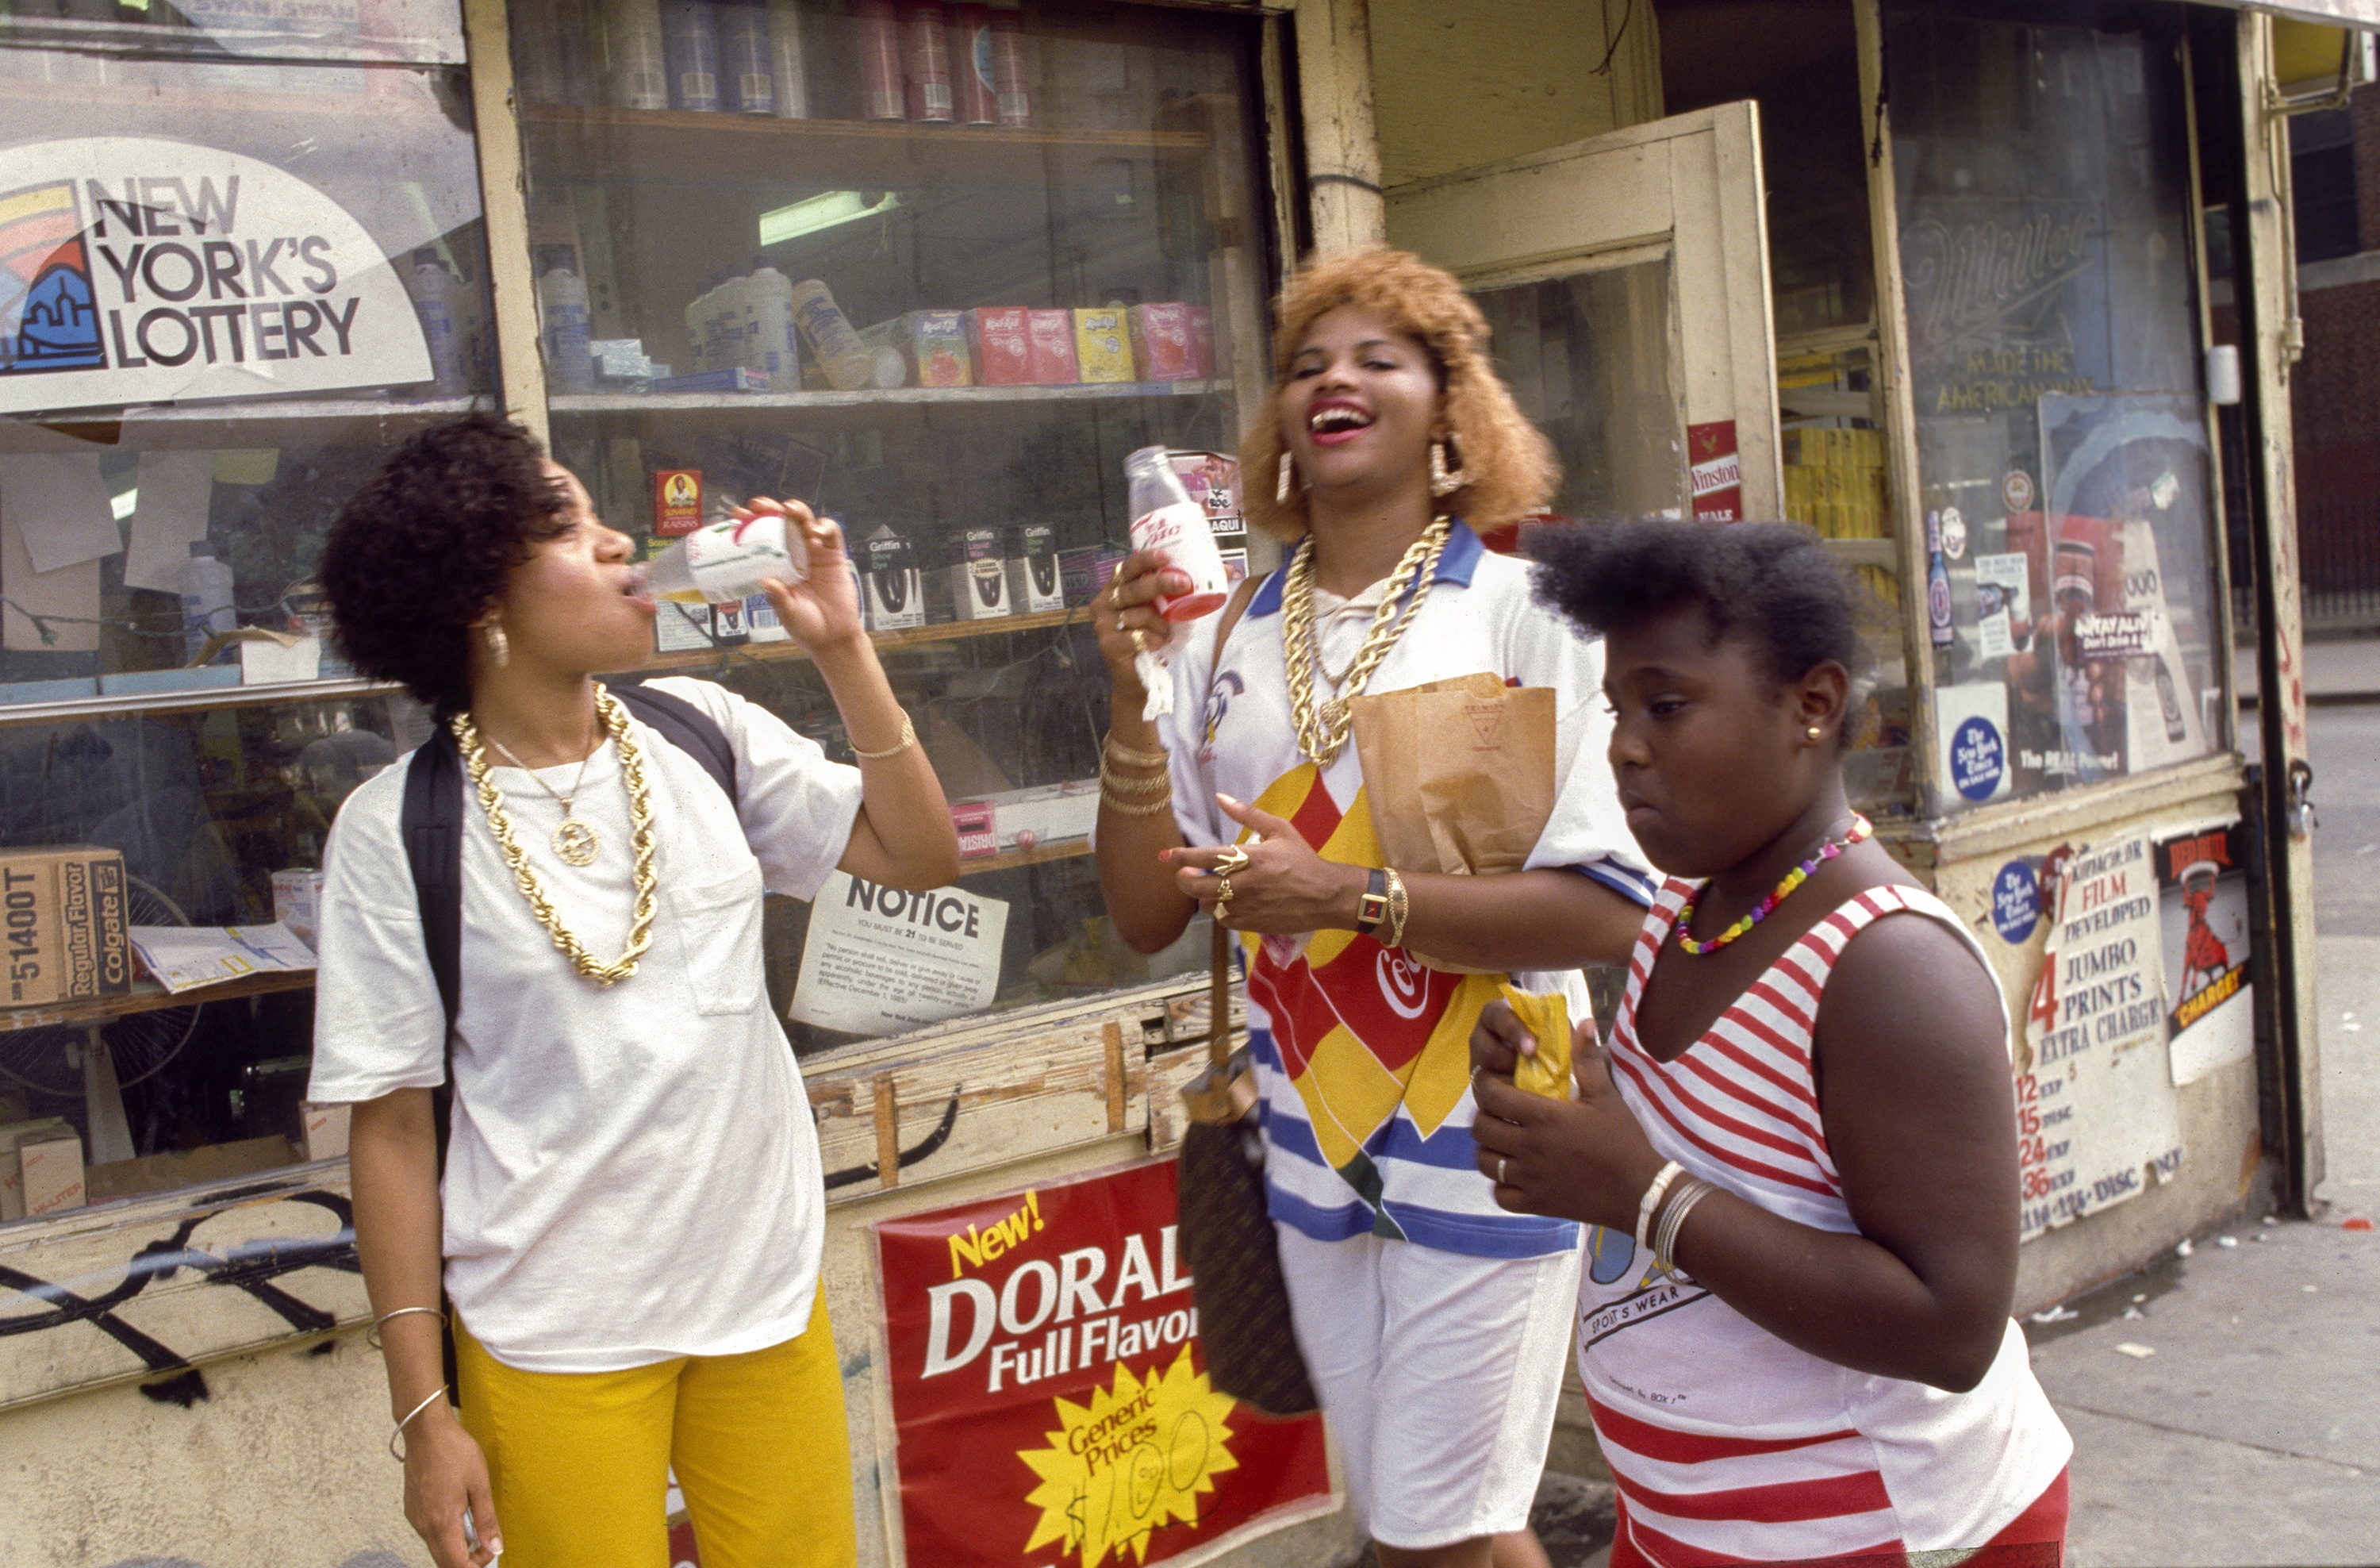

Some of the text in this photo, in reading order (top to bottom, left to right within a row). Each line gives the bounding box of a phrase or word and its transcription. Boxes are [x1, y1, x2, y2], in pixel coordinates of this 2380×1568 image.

[86, 175, 240, 237] NEW
[97, 236, 337, 304] YORK'S
[109, 297, 361, 369] LOTTERY
[2033, 347, 2070, 374] THE
[869, 540, 901, 552] Griffin
[966, 530, 994, 541] Griffin
[1025, 526, 1051, 537] Griffin
[2020, 748, 2044, 769] The
[958, 833, 997, 851] DRISTA
[846, 876, 979, 940] NOTICE
[2082, 871, 2128, 912] FILM
[4, 867, 40, 981] 51400T
[65, 861, 95, 998] Regular Flavor
[102, 894, 126, 985] Colgate
[857, 918, 873, 928] YOU
[873, 922, 892, 933] MUST
[904, 928, 916, 939] 21
[918, 933, 927, 942] TO
[938, 939, 964, 951] SERVED
[2063, 896, 2152, 943] DEVELOPED
[2064, 937, 2137, 985] JUMBO
[2030, 950, 2059, 1033] 4
[2064, 972, 2143, 1024] PRINTS
[2039, 997, 2161, 1067] EXTRA CHARGE
[2015, 1074, 2038, 1105] 12
[2017, 1105, 2041, 1135] 15
[2019, 1136, 2048, 1167] 24
[2022, 1166, 2052, 1201] 36
[2093, 1167, 2140, 1204] DISC
[947, 1188, 1045, 1279] New!
[919, 1224, 1195, 1379] DORAL
[1634, 1286, 1679, 1313] WEAR
[988, 1327, 1073, 1393] Full
[1649, 1389, 1669, 1405] BOX
[1066, 1385, 1158, 1458] Generic
[1084, 1415, 1158, 1478] Prices
